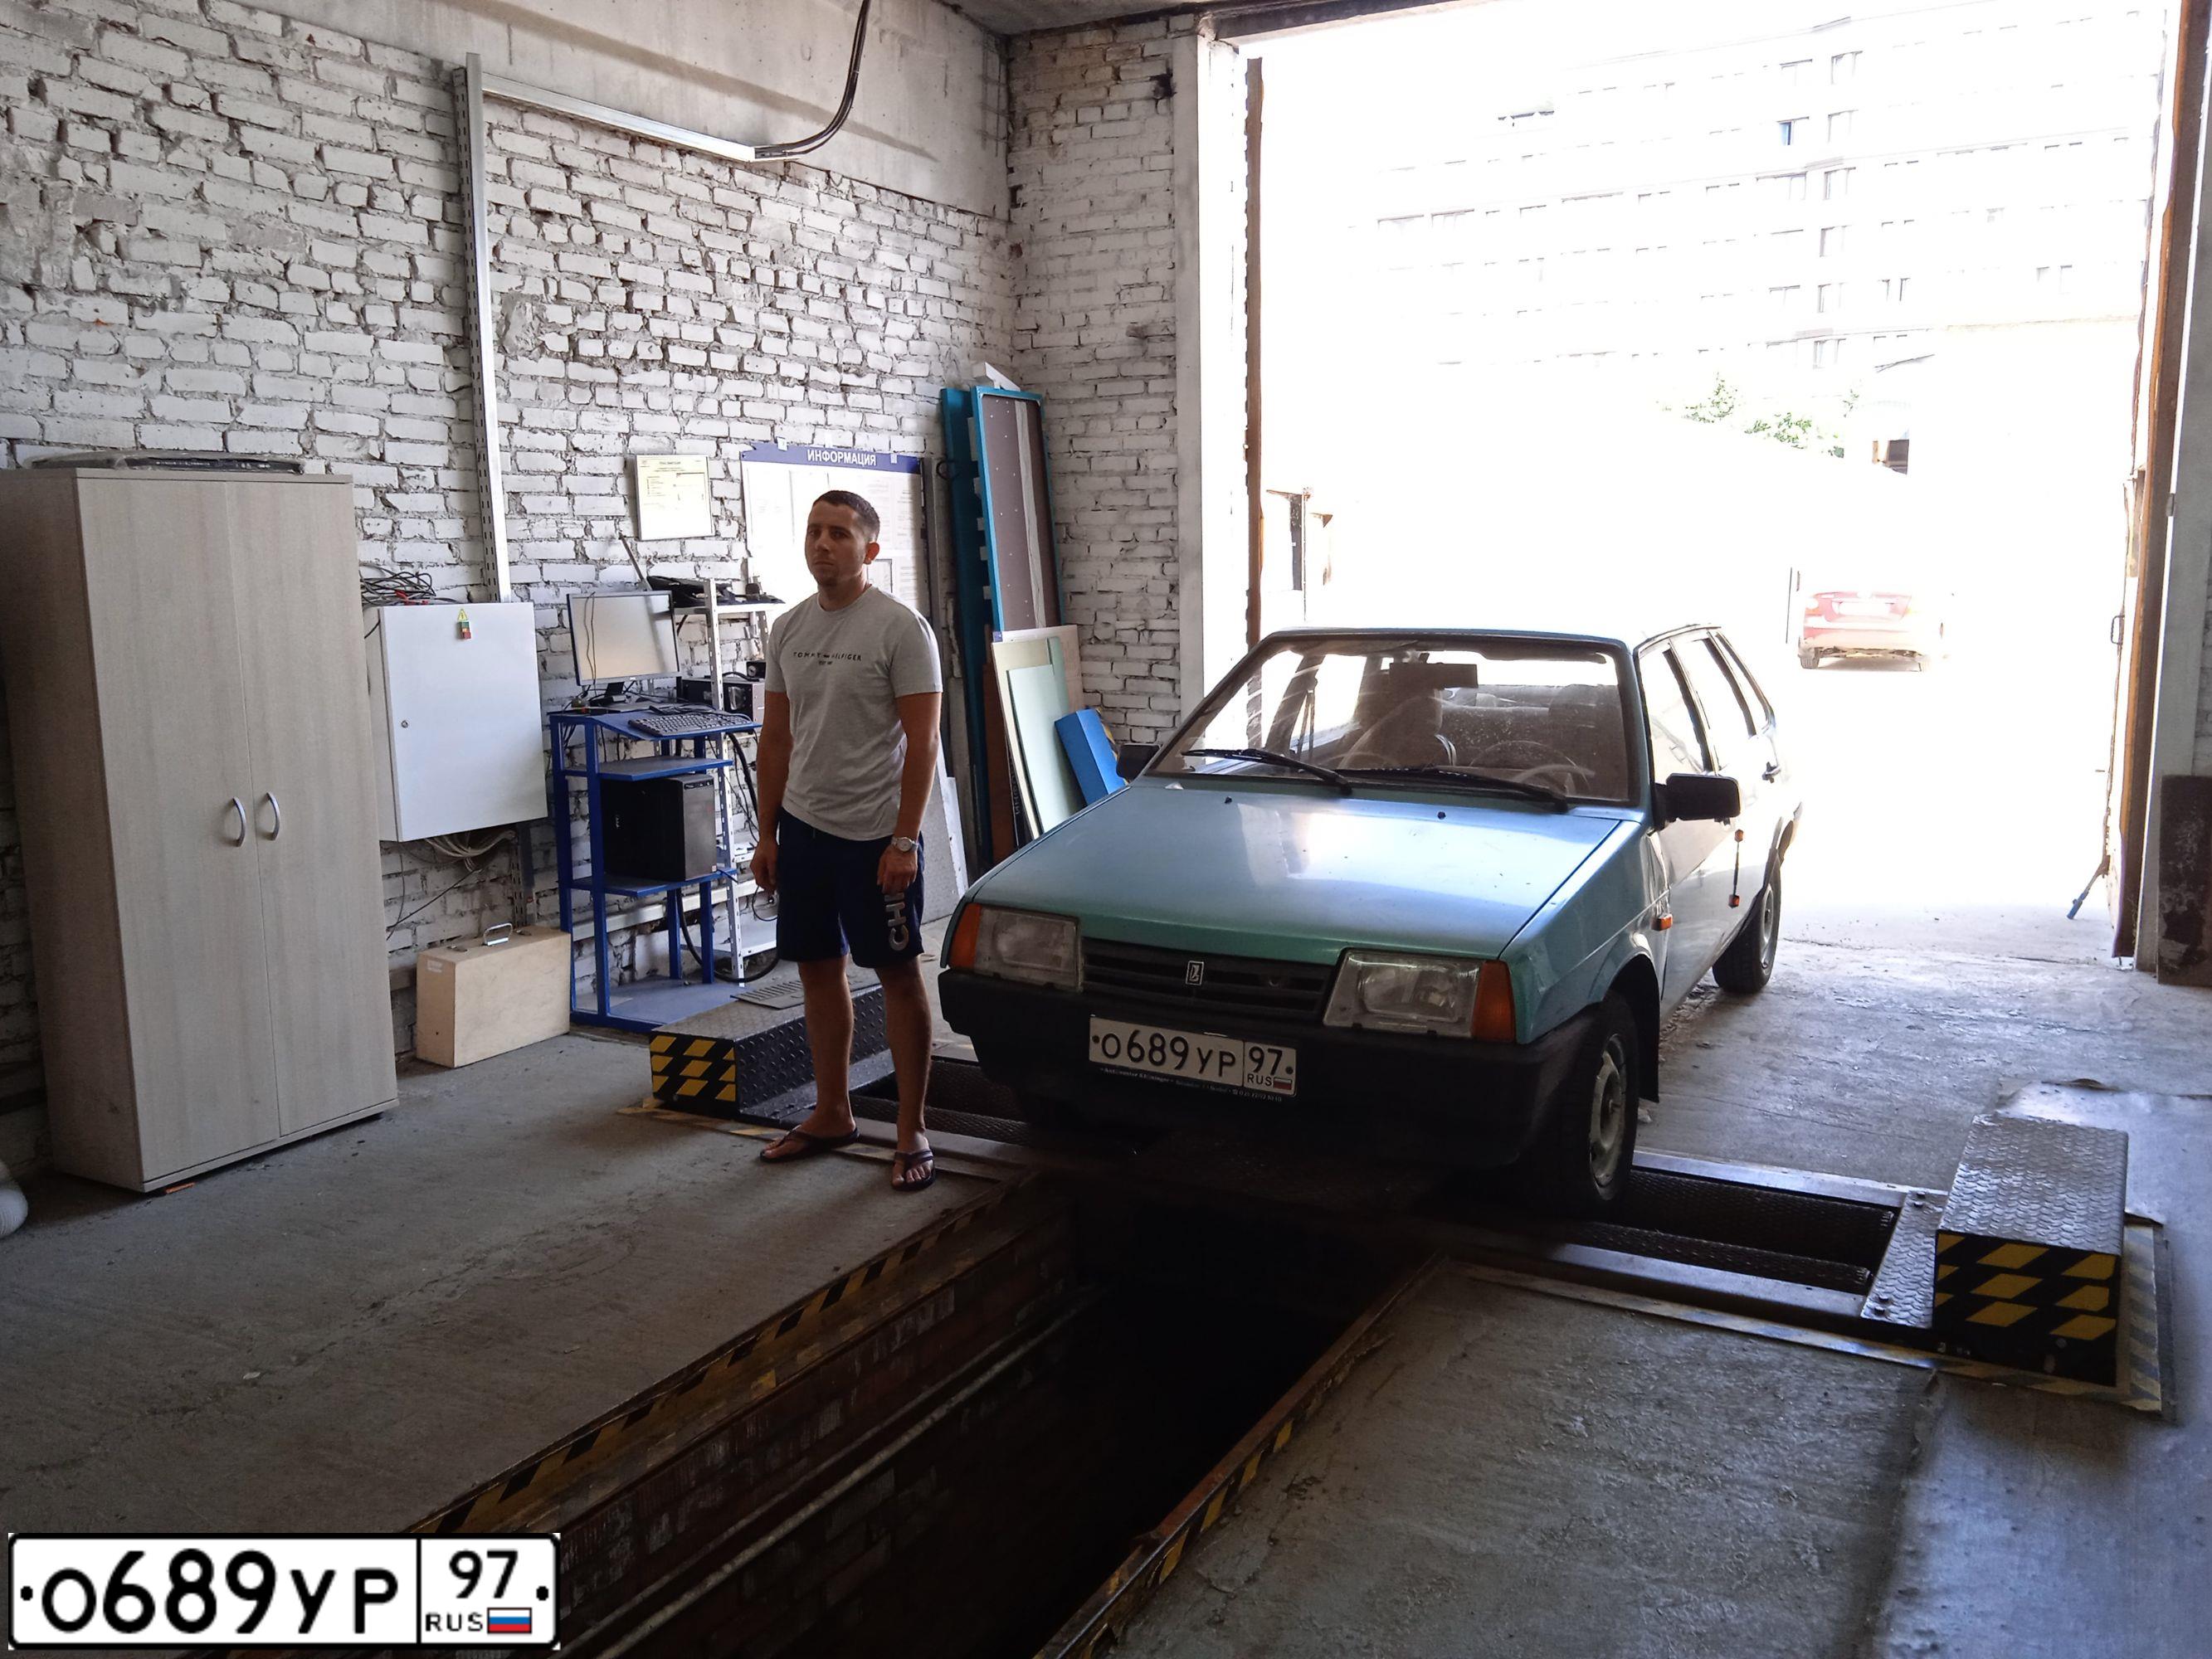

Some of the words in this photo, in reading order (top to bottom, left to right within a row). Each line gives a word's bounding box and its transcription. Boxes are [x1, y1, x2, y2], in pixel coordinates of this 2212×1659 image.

[806, 449, 877, 466] ИНФОРМАЦИЯ
[1248, 1046, 1283, 1076] 97
[1246, 1073, 1273, 1087] RUS
